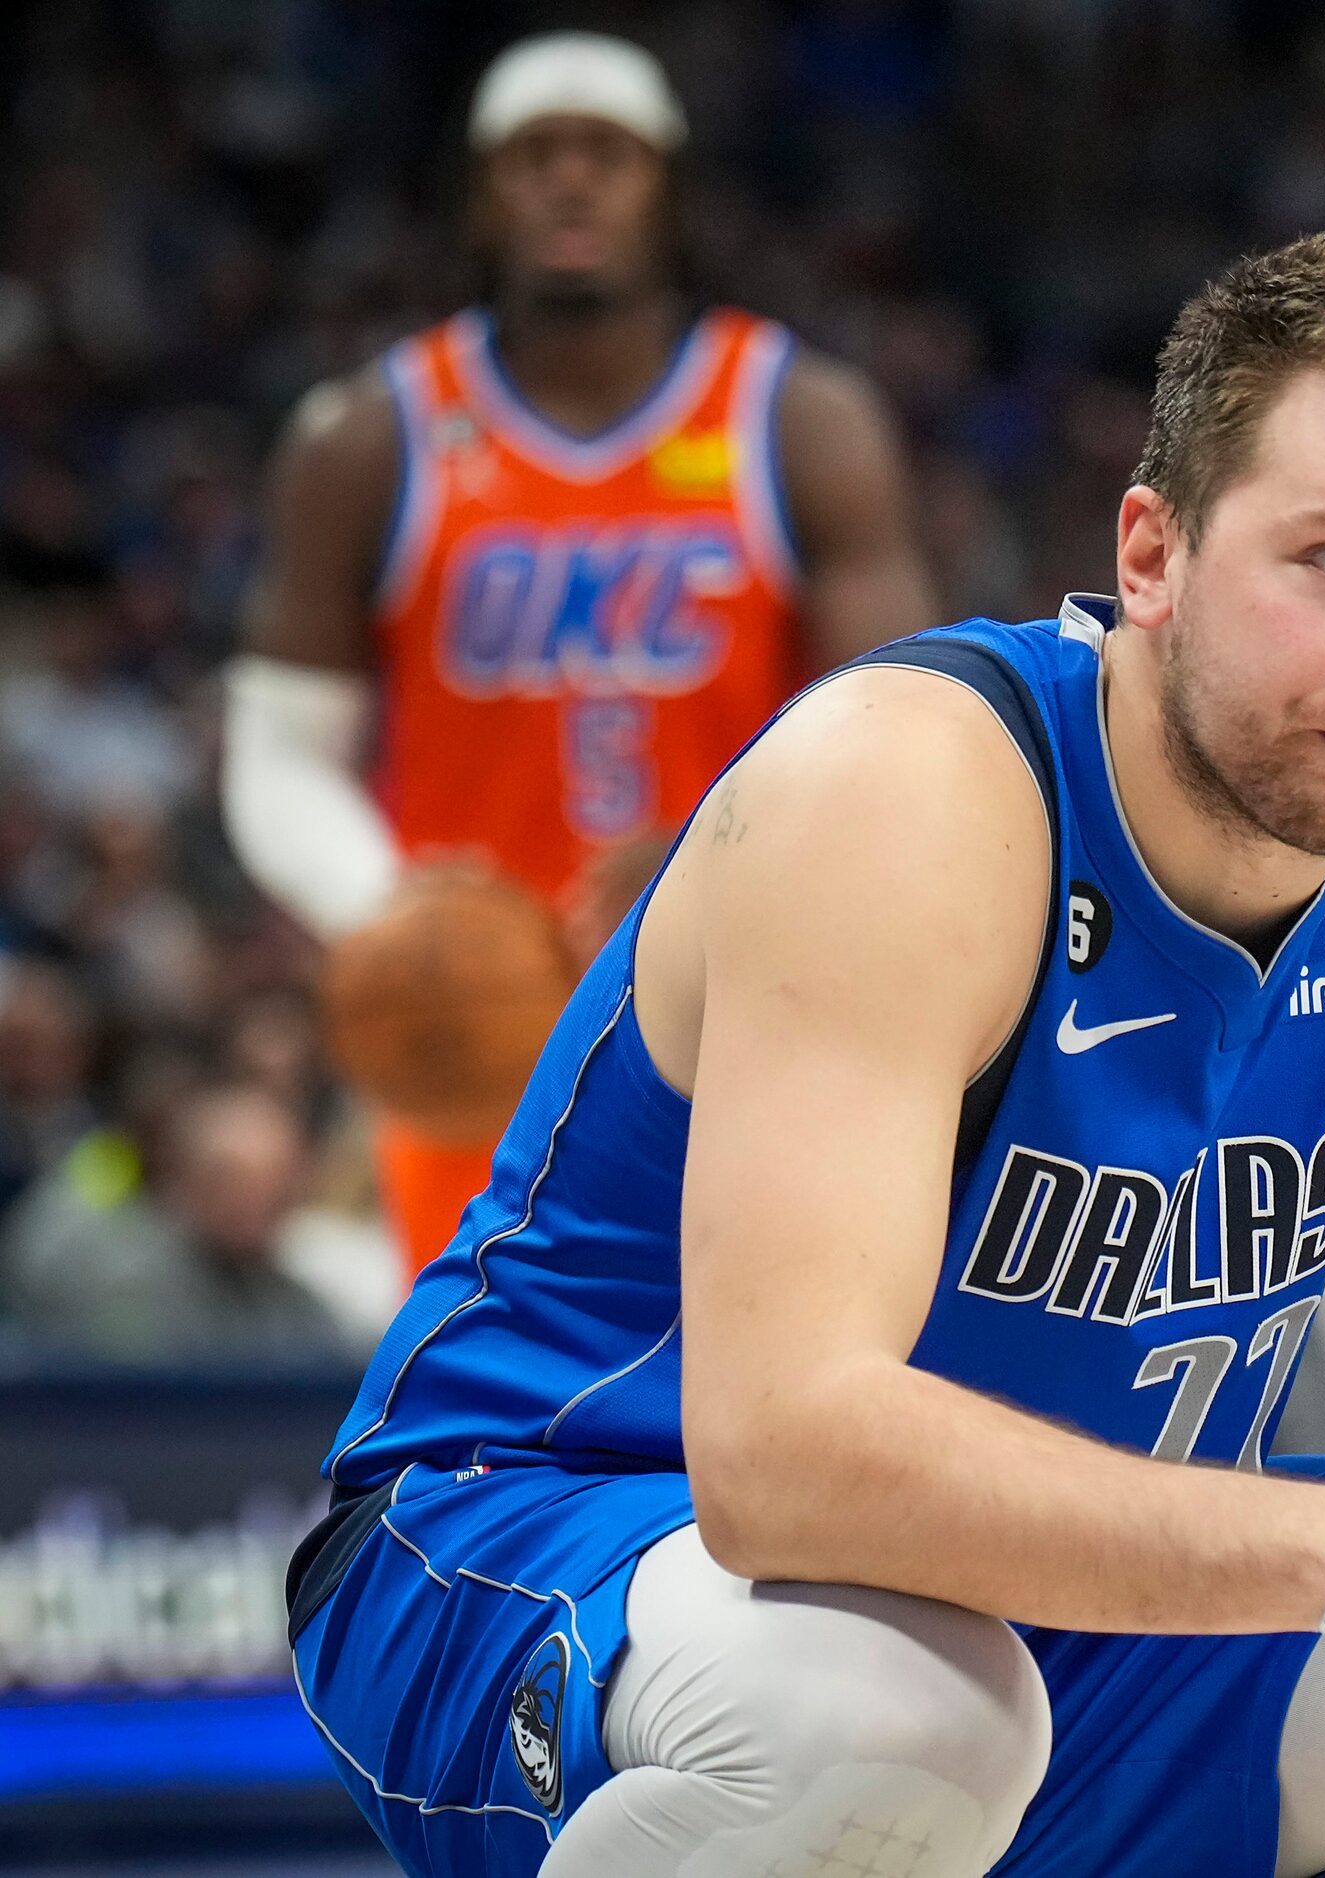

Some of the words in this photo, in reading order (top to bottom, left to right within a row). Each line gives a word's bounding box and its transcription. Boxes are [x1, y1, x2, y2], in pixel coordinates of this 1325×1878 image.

[438, 522, 744, 696] OKC
[1068, 894, 1096, 963] 6
[1131, 1295, 1321, 1476] 77
